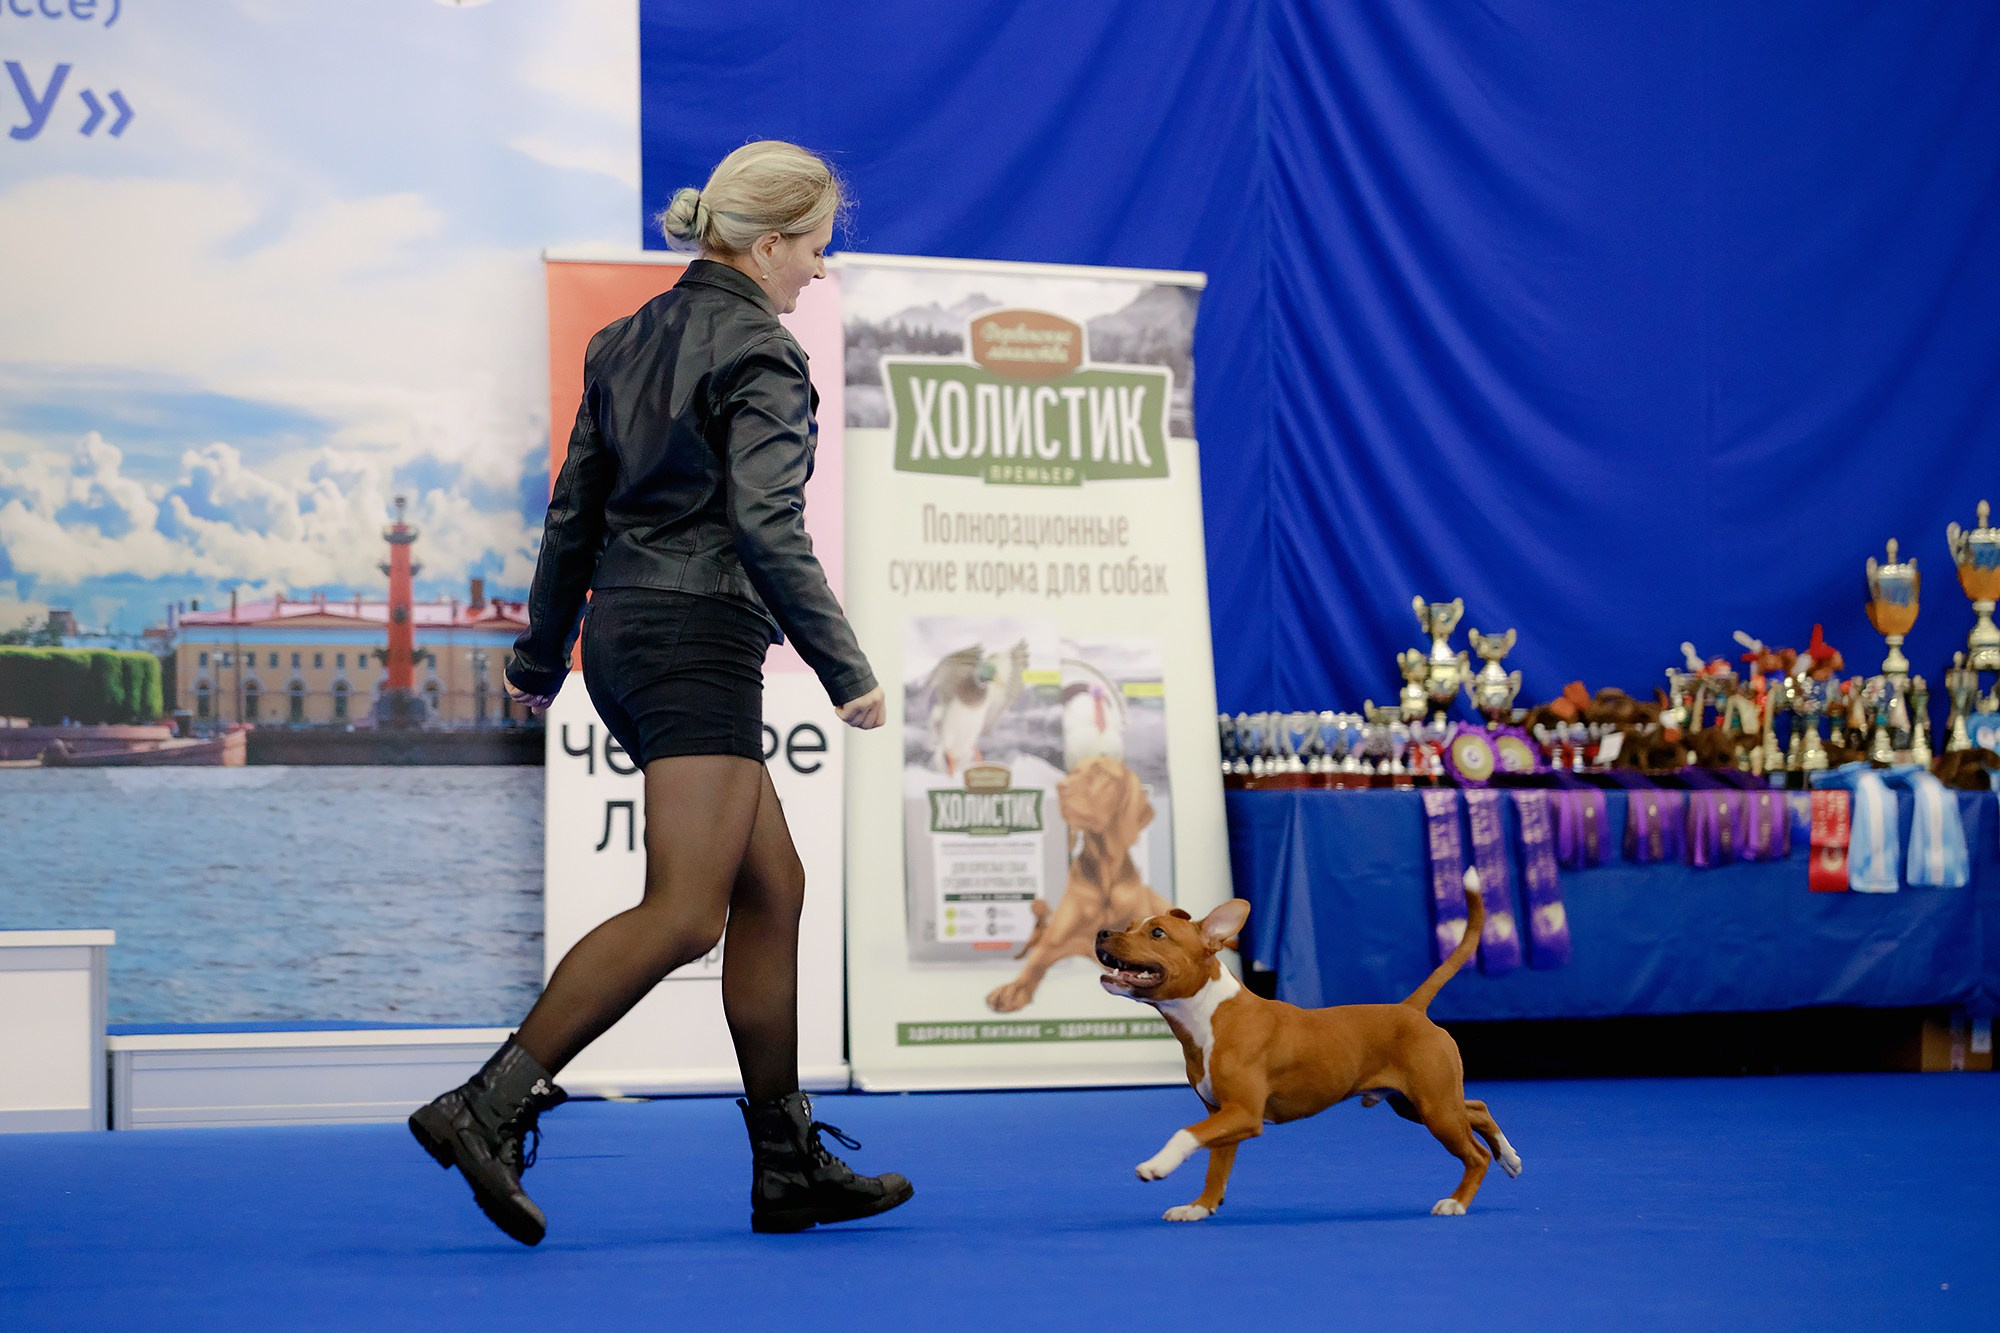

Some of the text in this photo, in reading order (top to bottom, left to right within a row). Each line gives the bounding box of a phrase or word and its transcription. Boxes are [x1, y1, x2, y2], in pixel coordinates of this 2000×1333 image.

[908, 375, 1152, 467] ХОЛИСТИК
[990, 464, 1076, 485] ПРЕМЬЕР
[922, 502, 1130, 549] Полнорационные
[889, 556, 1169, 599] сухие корма для собак
